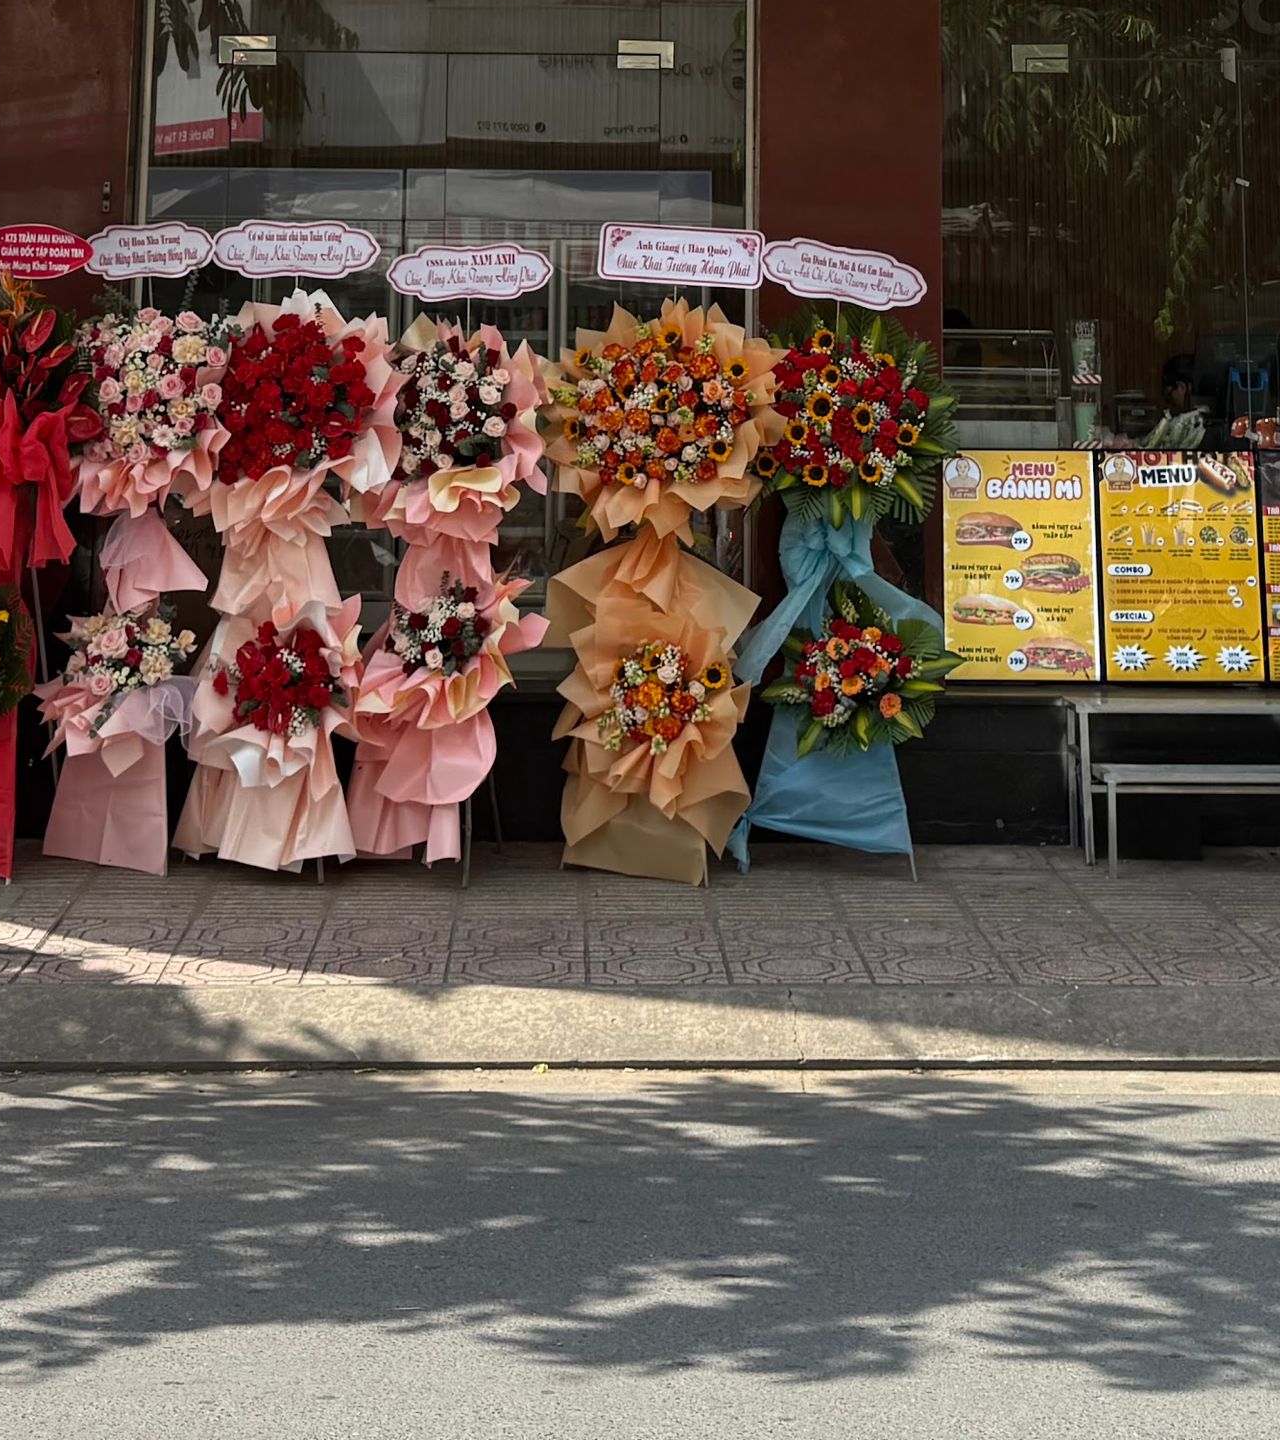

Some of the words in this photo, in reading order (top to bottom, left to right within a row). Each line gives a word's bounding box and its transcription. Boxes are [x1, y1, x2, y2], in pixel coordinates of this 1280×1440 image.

[1012, 463, 1055, 476] MENU
[1141, 468, 1192, 484] MENU
[986, 475, 1051, 499] BÁNH
[1054, 475, 1082, 499] MÌ
